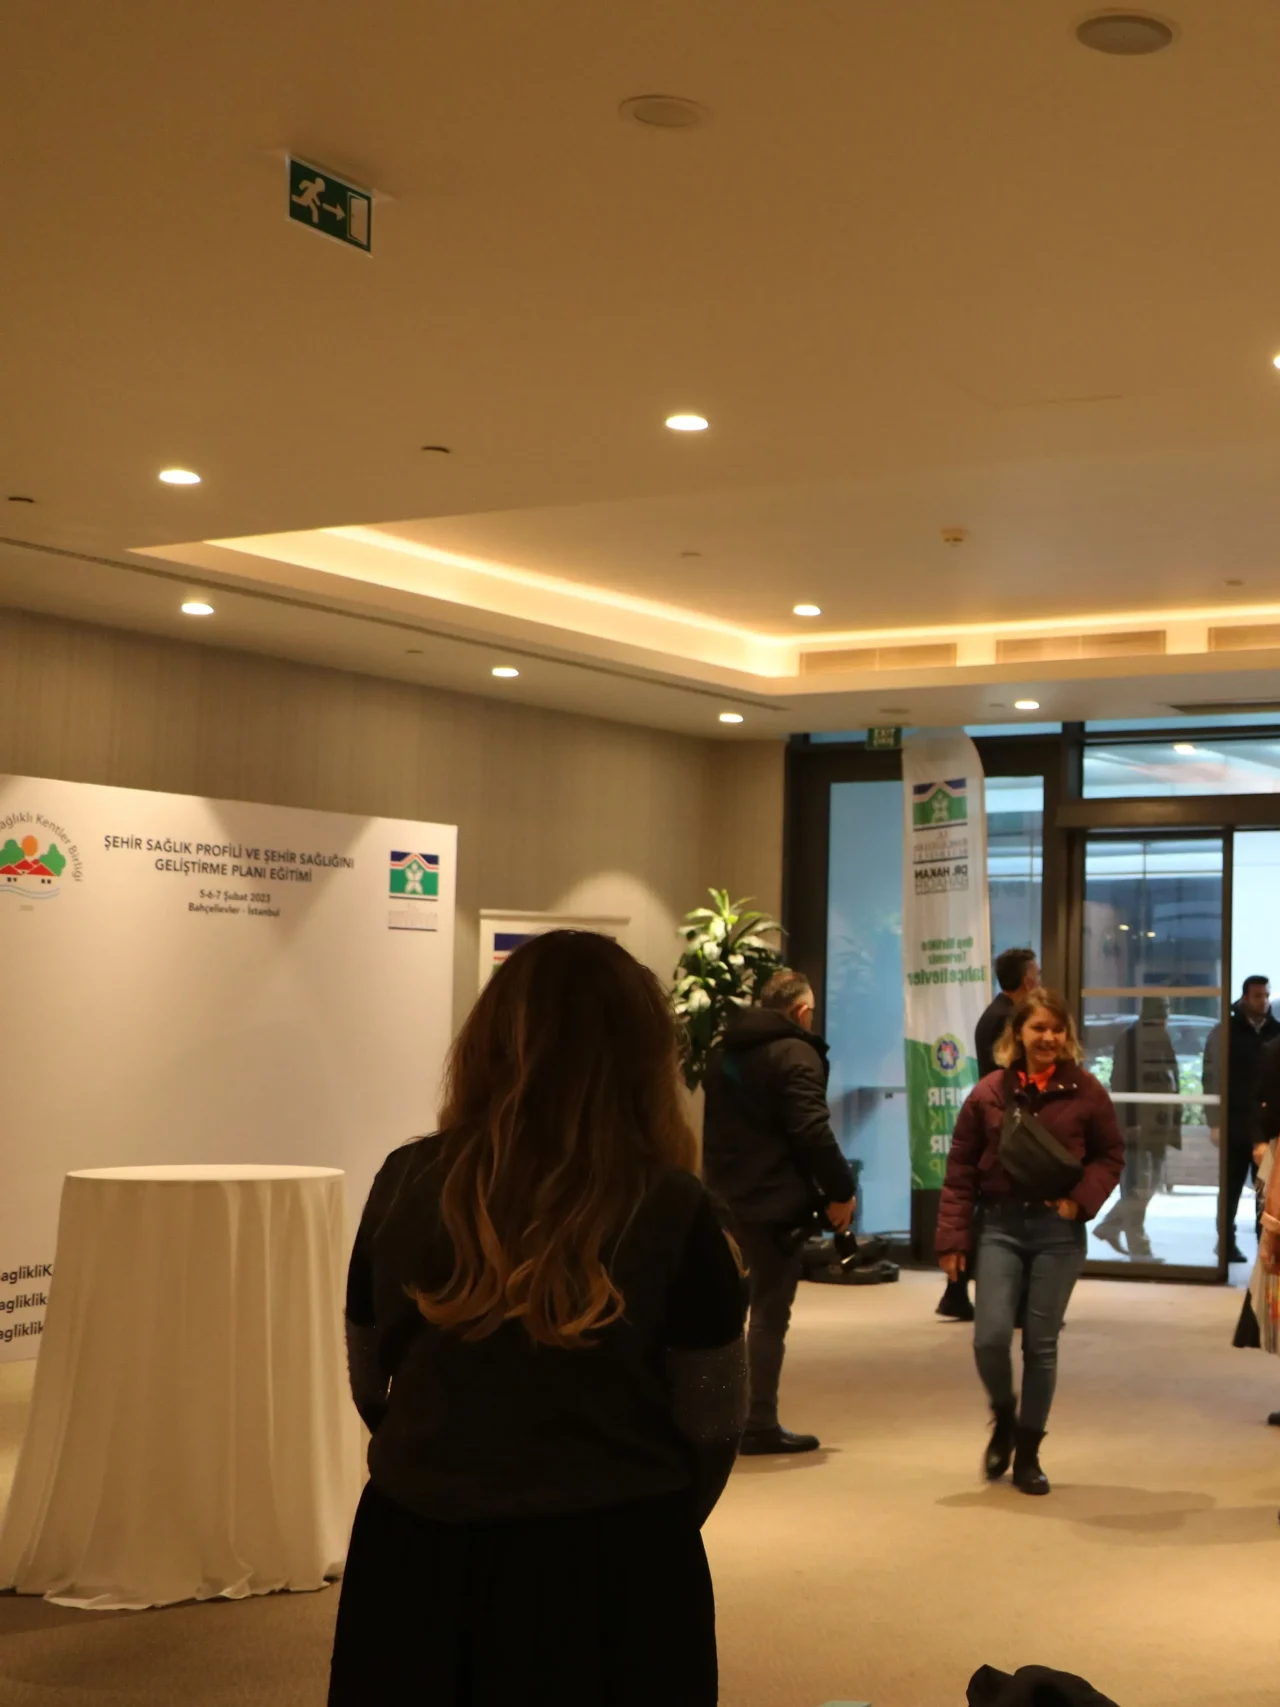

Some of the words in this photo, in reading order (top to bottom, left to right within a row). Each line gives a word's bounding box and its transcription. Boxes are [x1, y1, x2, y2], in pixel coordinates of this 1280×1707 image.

[0, 812, 33, 829] ağlıklı
[35, 813, 71, 844] Kentler
[104, 834, 142, 850] ŞEHİR
[146, 837, 192, 854] SAĞLIK
[196, 843, 242, 859] PROFİLİ
[245, 848, 260, 860] VE
[264, 848, 296, 864] ŞEHİR
[300, 851, 354, 868] SAĞLIĞINI
[155, 858, 228, 876] GELİŞTİRME
[232, 865, 266, 878] PLANI
[270, 867, 312, 882] EĞİTİMİ
[224, 891, 248, 902] Şubat
[188, 902, 239, 914] Bahçelievler
[248, 904, 280, 916] İstanbul
[0, 1264, 52, 1284] aglikliK
[0, 1292, 48, 1313] agliklik
[0, 1321, 43, 1342] agliklik
